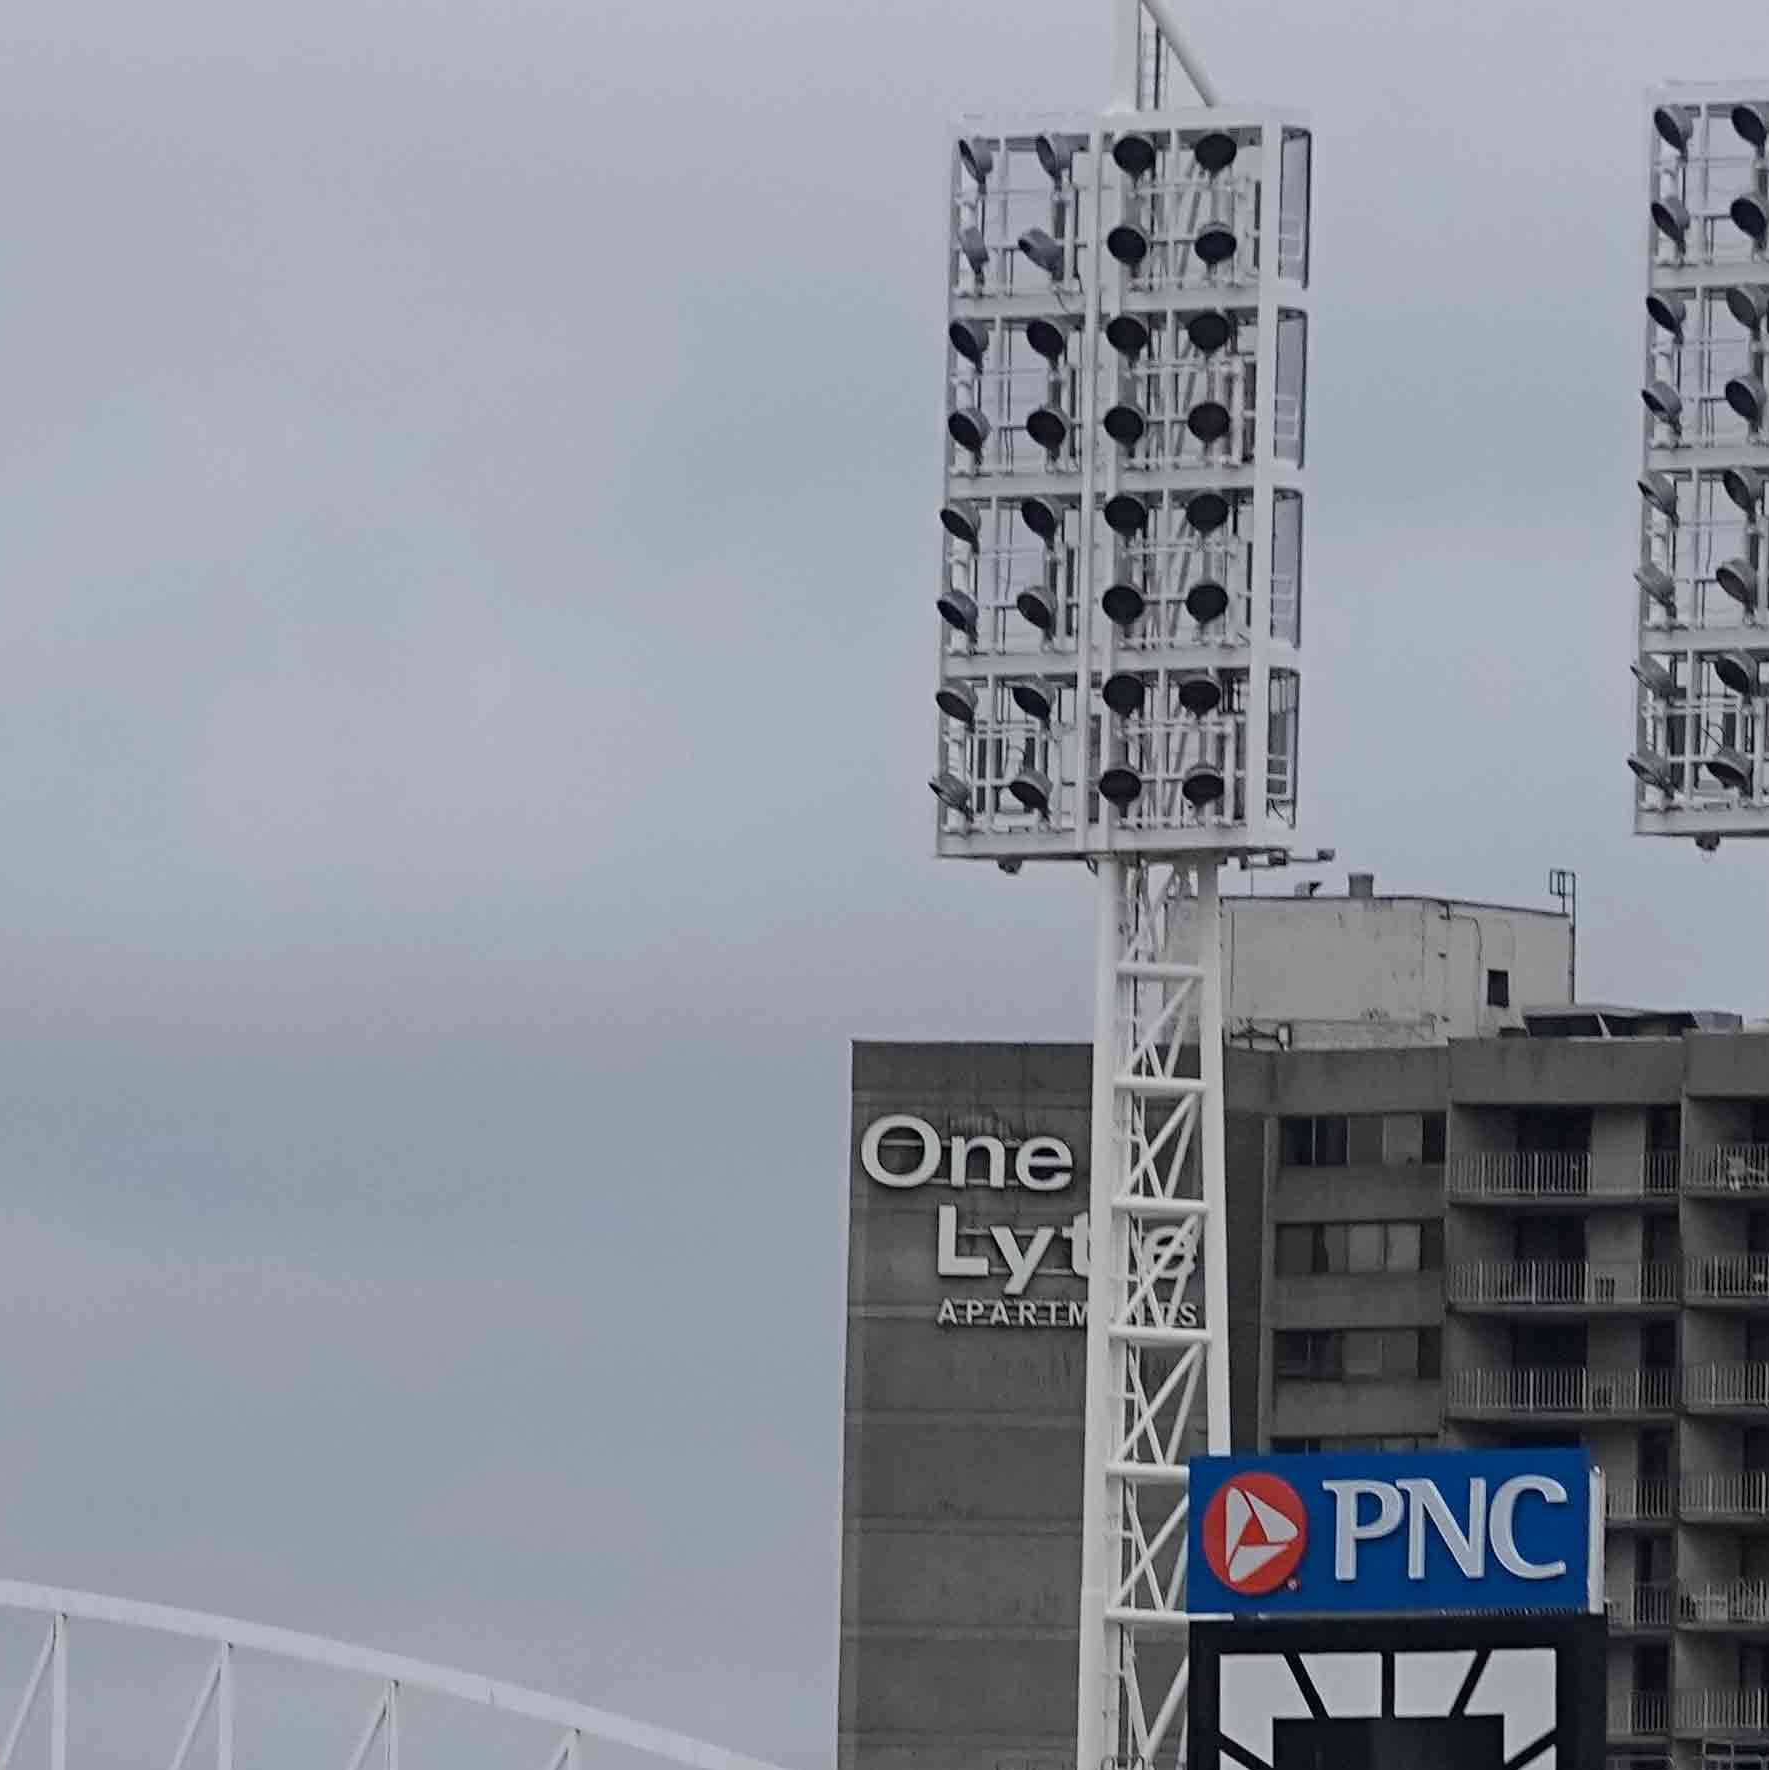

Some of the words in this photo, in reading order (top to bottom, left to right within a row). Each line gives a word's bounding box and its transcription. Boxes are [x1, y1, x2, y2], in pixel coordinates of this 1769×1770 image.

[861, 1114, 1074, 1191] One
[937, 1204, 1197, 1295] Lyte
[1322, 1475, 1568, 1580] PNC
